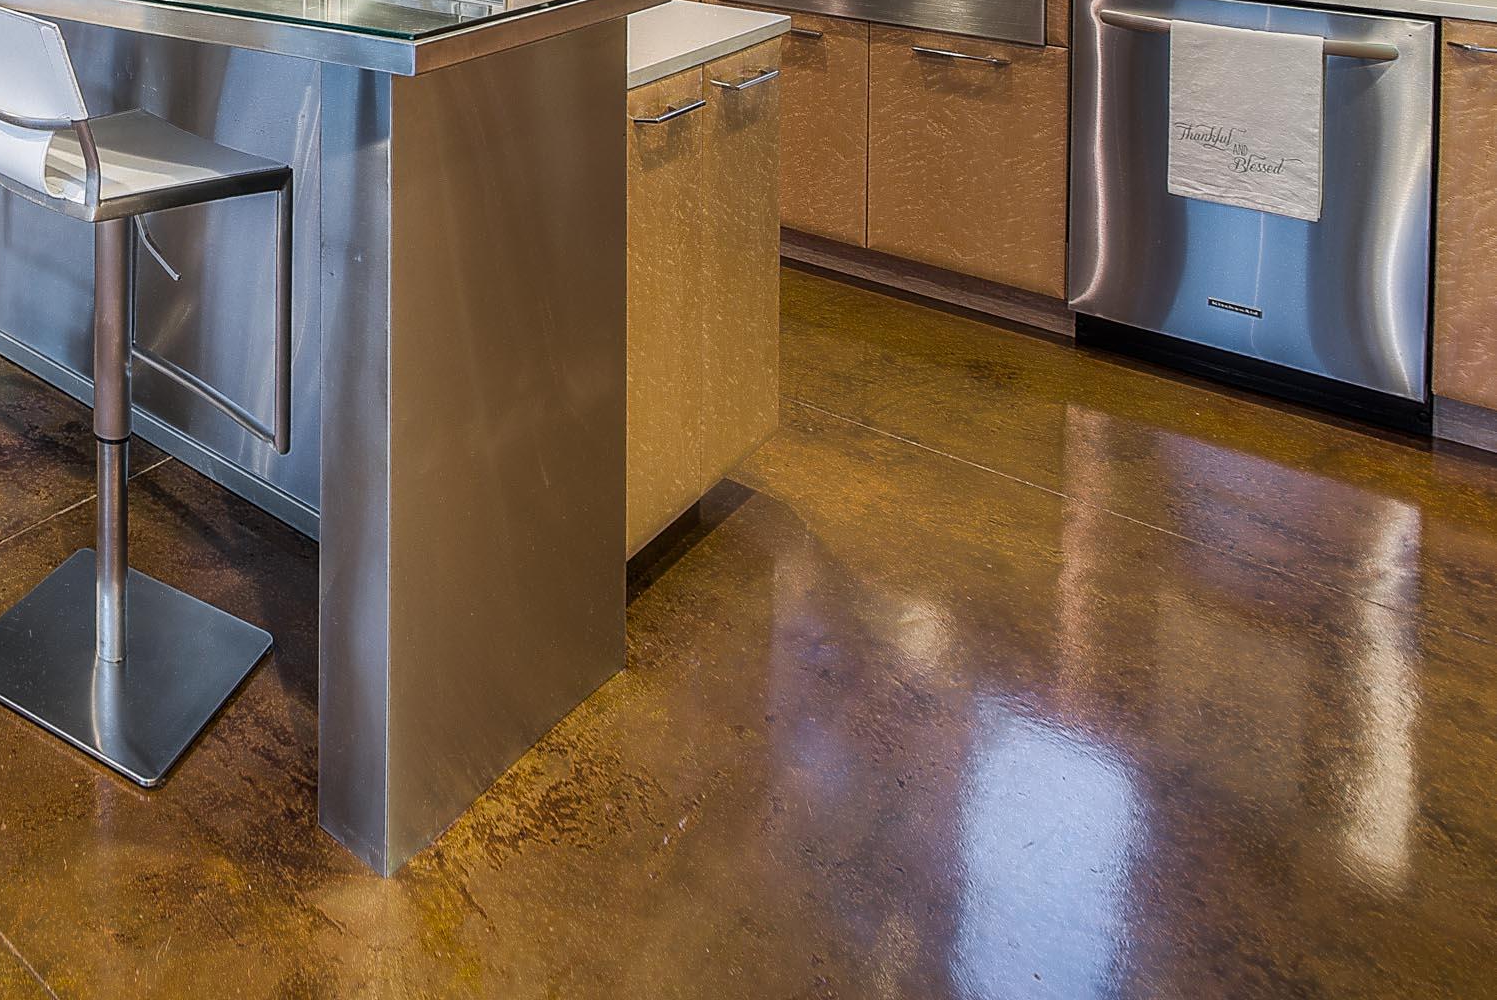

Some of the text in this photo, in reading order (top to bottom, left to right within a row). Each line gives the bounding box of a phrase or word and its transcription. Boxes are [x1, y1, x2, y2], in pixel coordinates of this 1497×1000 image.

[1174, 122, 1247, 151] Thankful
[1233, 143, 1248, 156] AND
[1228, 154, 1303, 174] Blessed
